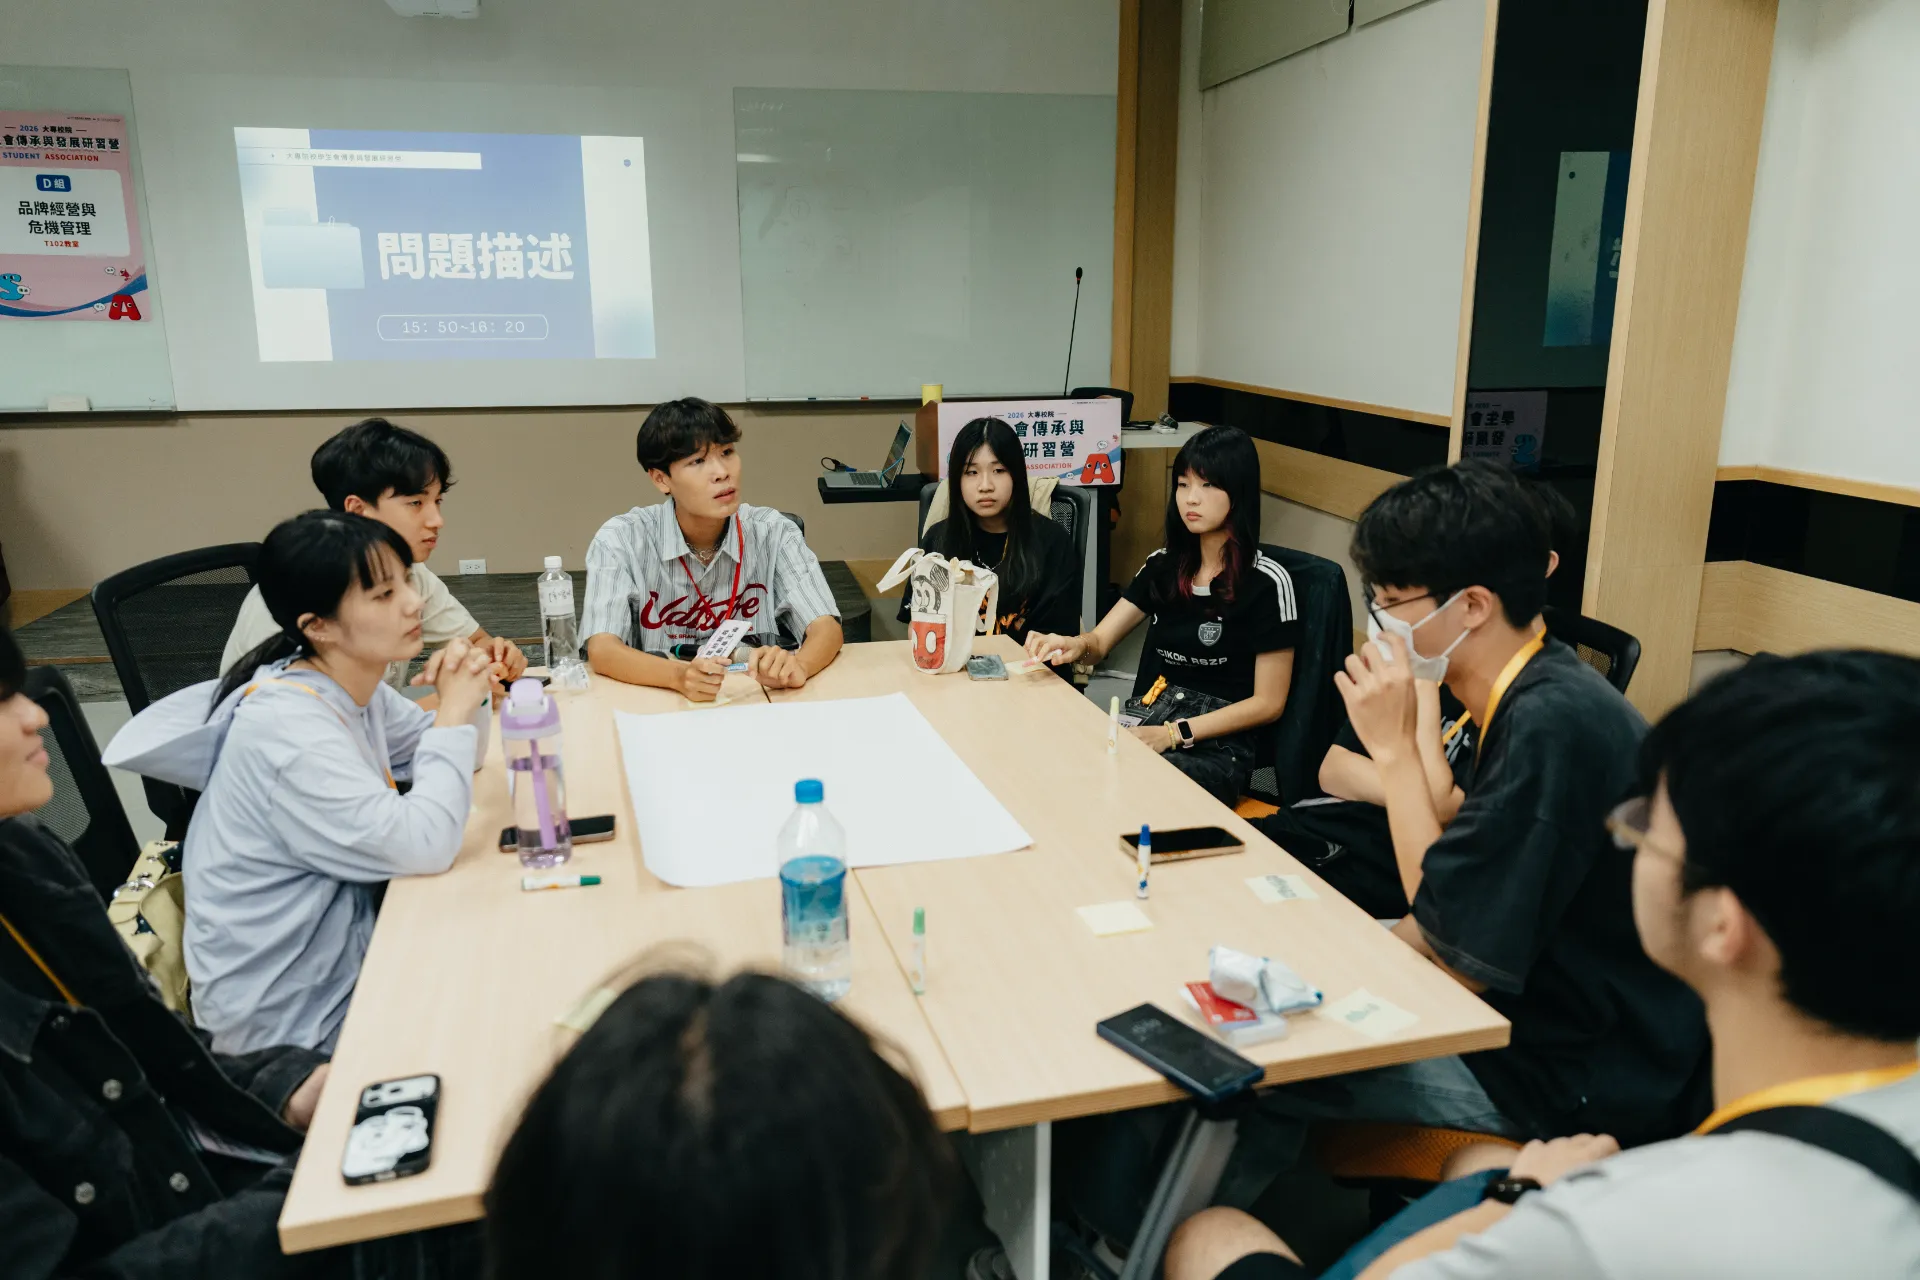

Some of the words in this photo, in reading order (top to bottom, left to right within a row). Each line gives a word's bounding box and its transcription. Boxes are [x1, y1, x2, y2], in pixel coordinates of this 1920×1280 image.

[19, 124, 39, 132] 2026
[42, 125, 73, 134] 大專校院
[0, 134, 120, 150] 會傳承與發展研習營
[2, 151, 40, 160] STUDENT
[44, 153, 99, 162] ASSOCIATION
[18, 200, 97, 217] 品牌經營與
[28, 219, 92, 236] 危機管理
[43, 240, 80, 248] T102教室
[377, 231, 575, 282] 問題描述
[1027, 410, 1055, 418] 大專校院
[1026, 462, 1072, 470] ASSOCIATION
